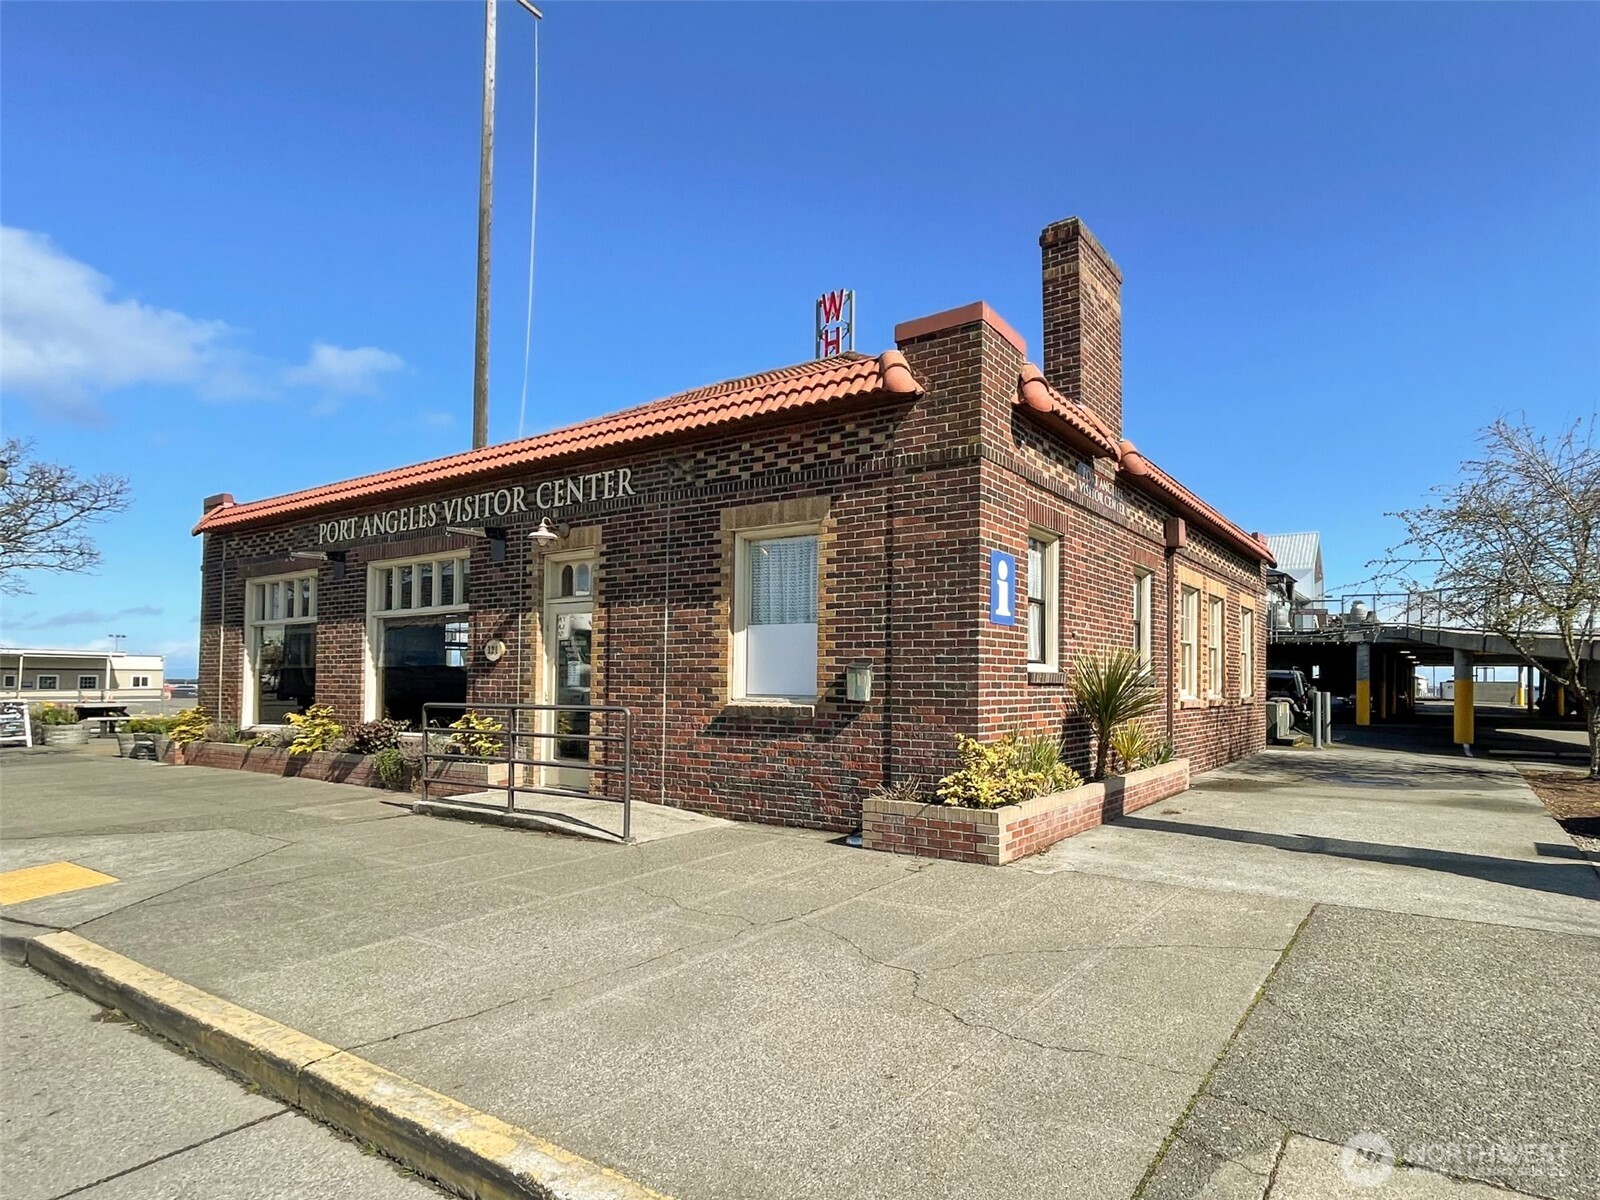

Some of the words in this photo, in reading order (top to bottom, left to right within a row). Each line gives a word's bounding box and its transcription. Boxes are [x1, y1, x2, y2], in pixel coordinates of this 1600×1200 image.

[318, 516, 359, 544] PORT
[361, 503, 437, 536] ANGELES
[442, 487, 528, 523] VISITOR
[536, 468, 636, 509] CENTER
